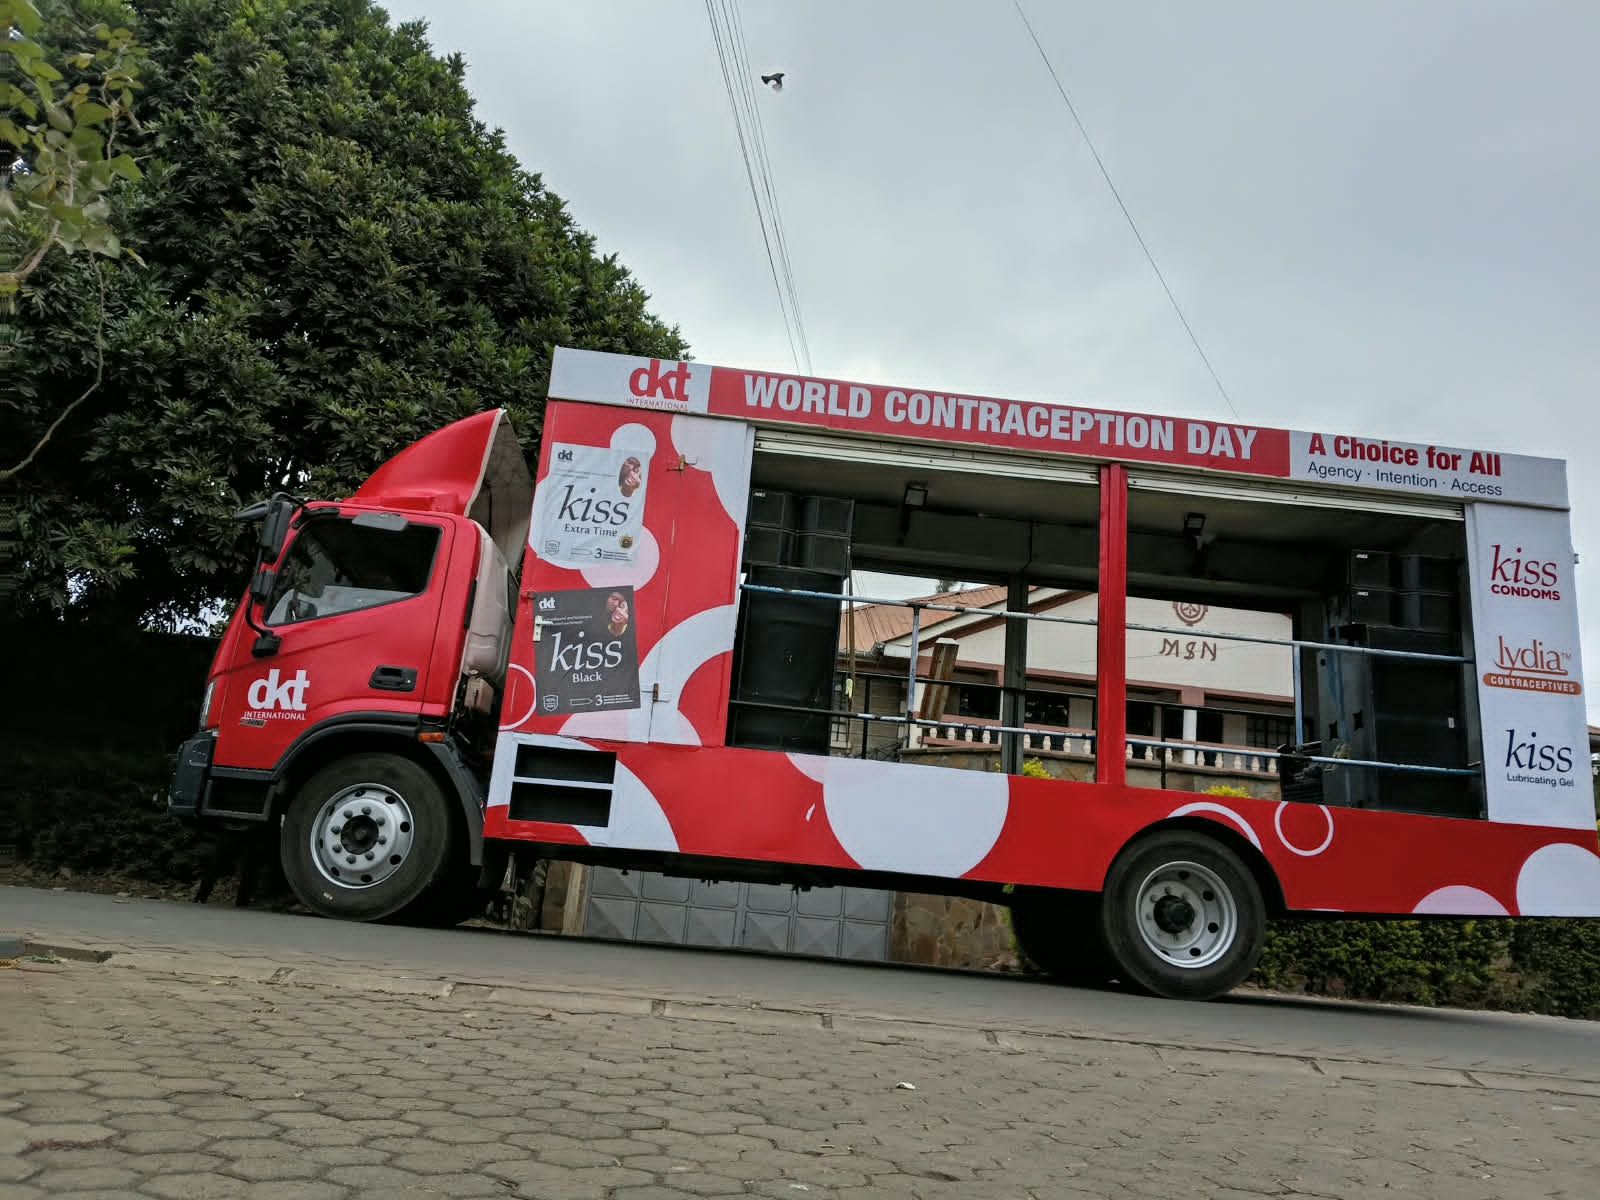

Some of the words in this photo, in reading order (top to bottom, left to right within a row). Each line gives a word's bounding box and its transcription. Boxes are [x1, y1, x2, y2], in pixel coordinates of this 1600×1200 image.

[629, 358, 692, 401] dkt
[626, 398, 688, 411] INTERNATIONAL
[744, 374, 871, 419] WORLD
[884, 390, 1174, 451] CONTRACEPTION
[1187, 423, 1257, 459] DAY
[557, 449, 574, 462] dkt
[1308, 433, 1327, 455] A
[1334, 435, 1419, 466] Choice
[1426, 445, 1462, 471] for
[1469, 451, 1502, 477] All
[1308, 461, 1362, 482] Agency
[1376, 469, 1437, 489] Intention
[1450, 478, 1503, 496] Access
[558, 484, 630, 525] kiss
[564, 523, 590, 535] Extra
[593, 526, 618, 537] Time
[594, 548, 602, 559] 3
[1490, 543, 1558, 587] kiss
[1491, 584, 1561, 600] CONDOMS
[538, 597, 556, 610] dkt
[550, 631, 622, 672] kiss
[1494, 635, 1563, 677] lydia
[572, 671, 602, 683] Black
[1490, 675, 1575, 693] CONTRACEPTIVES
[247, 668, 310, 711] dkt
[594, 694, 603, 706] 3
[243, 711, 306, 720] INTERNATIONAL
[1505, 728, 1572, 773] kiss
[1507, 772, 1557, 788] Lubricating
[1559, 778, 1574, 787] Gel
